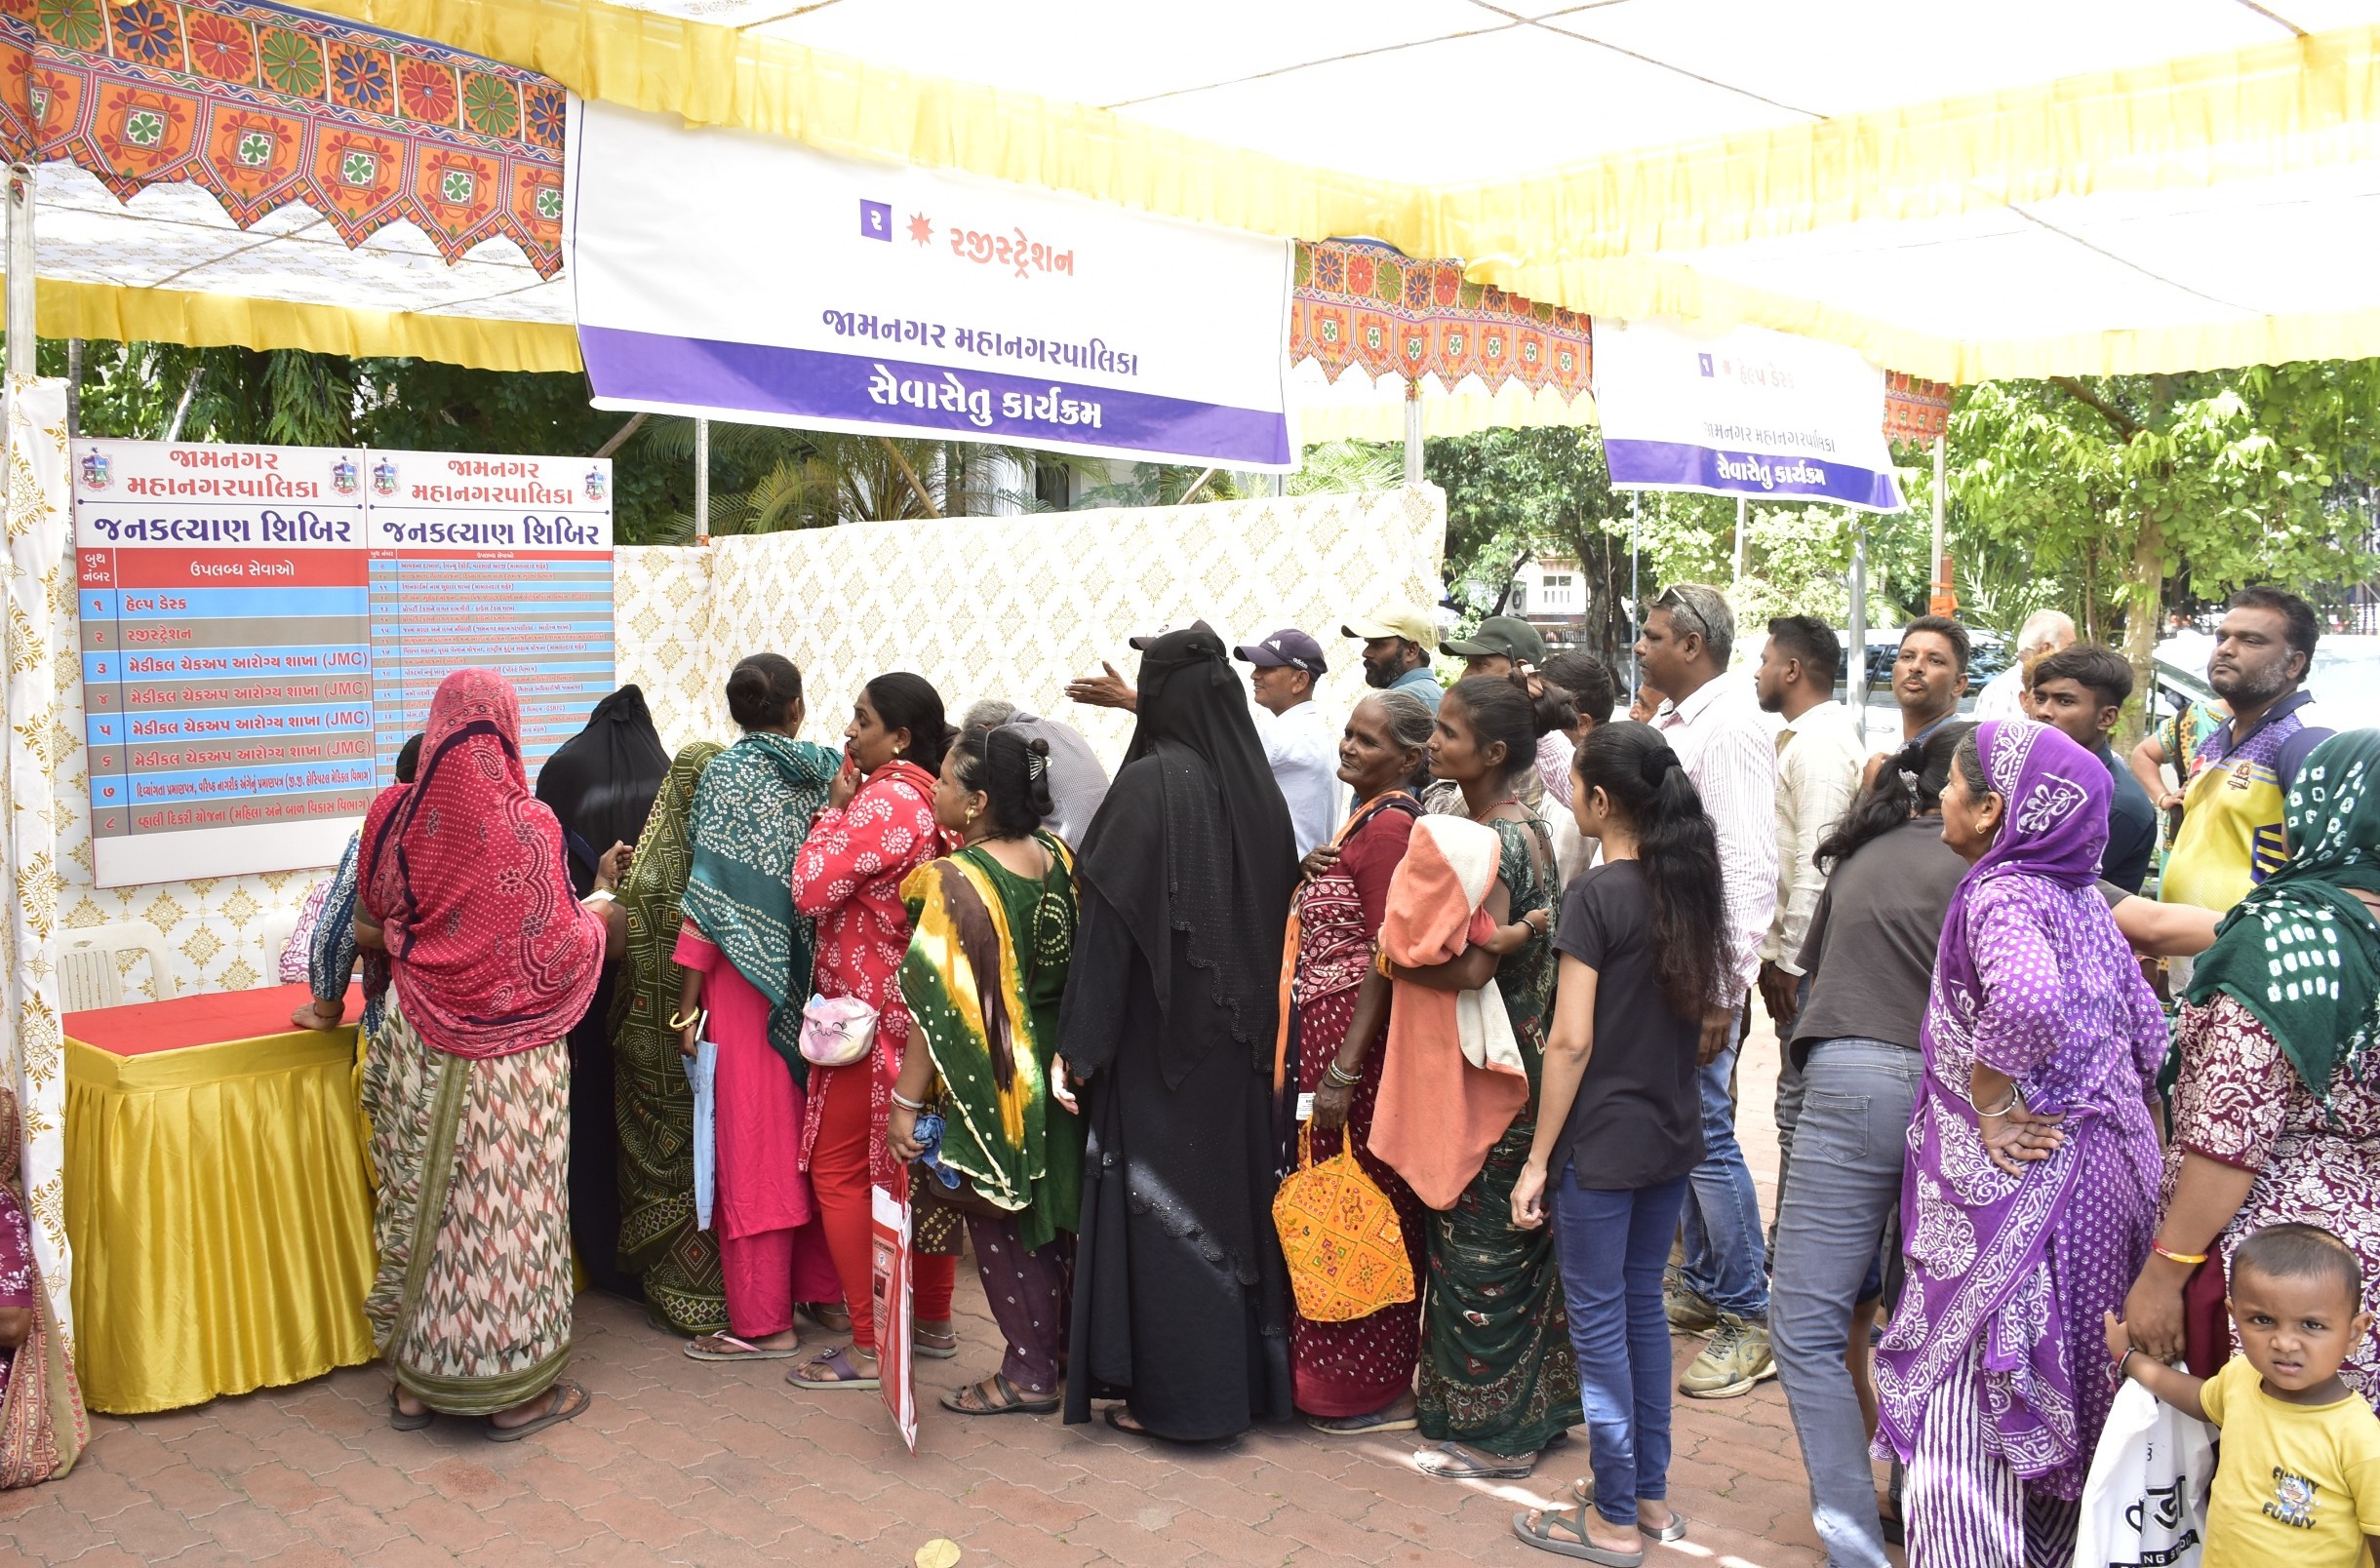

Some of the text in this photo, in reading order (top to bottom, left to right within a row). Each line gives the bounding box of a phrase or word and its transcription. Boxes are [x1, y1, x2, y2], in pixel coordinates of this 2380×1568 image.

[949, 226, 1074, 280] રજીસ્ટ્રેશન
[822, 309, 1139, 376] જામનગર મહાનગરપાલિકા
[867, 364, 1103, 429] સેવાસેતુ કાર્યક્રમ
[1755, 428, 1836, 453] મહાનગરપાલિકા
[169, 450, 278, 470] જામનગર
[448, 459, 539, 478] જામનગર
[1717, 452, 1827, 490] સેવાસેતુ કાર્યક્રમ
[127, 473, 319, 498] મહાનગરપાલિકા
[412, 481, 573, 504] મહાનગરપાલિકા
[94, 510, 351, 542] જનકલ્યાણ શિબિર
[382, 515, 599, 545] જનકલ્યાણ શિબિર
[85, 553, 106, 568] બુથ
[190, 559, 295, 577] ઉપલબ્ધ સેવાઓ
[83, 569, 110, 583] નંબર
[93, 595, 187, 611] ૧ હેલ્પ ડેસ્ક
[96, 624, 192, 645] ૨ રજીસ્ટ્રેશન
[98, 651, 368, 674] ૩ મેડીકલ ચેકઅપ આરોગ્ય શાખા (JMC)
[99, 681, 369, 705] ૪ મેડીકલ ચેકઅપ આરોગ્ય શાખા (JMC)
[99, 710, 370, 736] ૫ મેડીકલ ચેકઅપ આરોગ્ય શાખા (JMC)
[101, 740, 371, 767] ૬ મેડીકલ ચેકઅપ આરોગ્ય શાખા (JMC)
[102, 787, 114, 799] ૭
[105, 796, 370, 828] ૮ વ્હાલી દિકરી યોજના (મહિલા અને બાળ વિકાસ વિભાગ)
